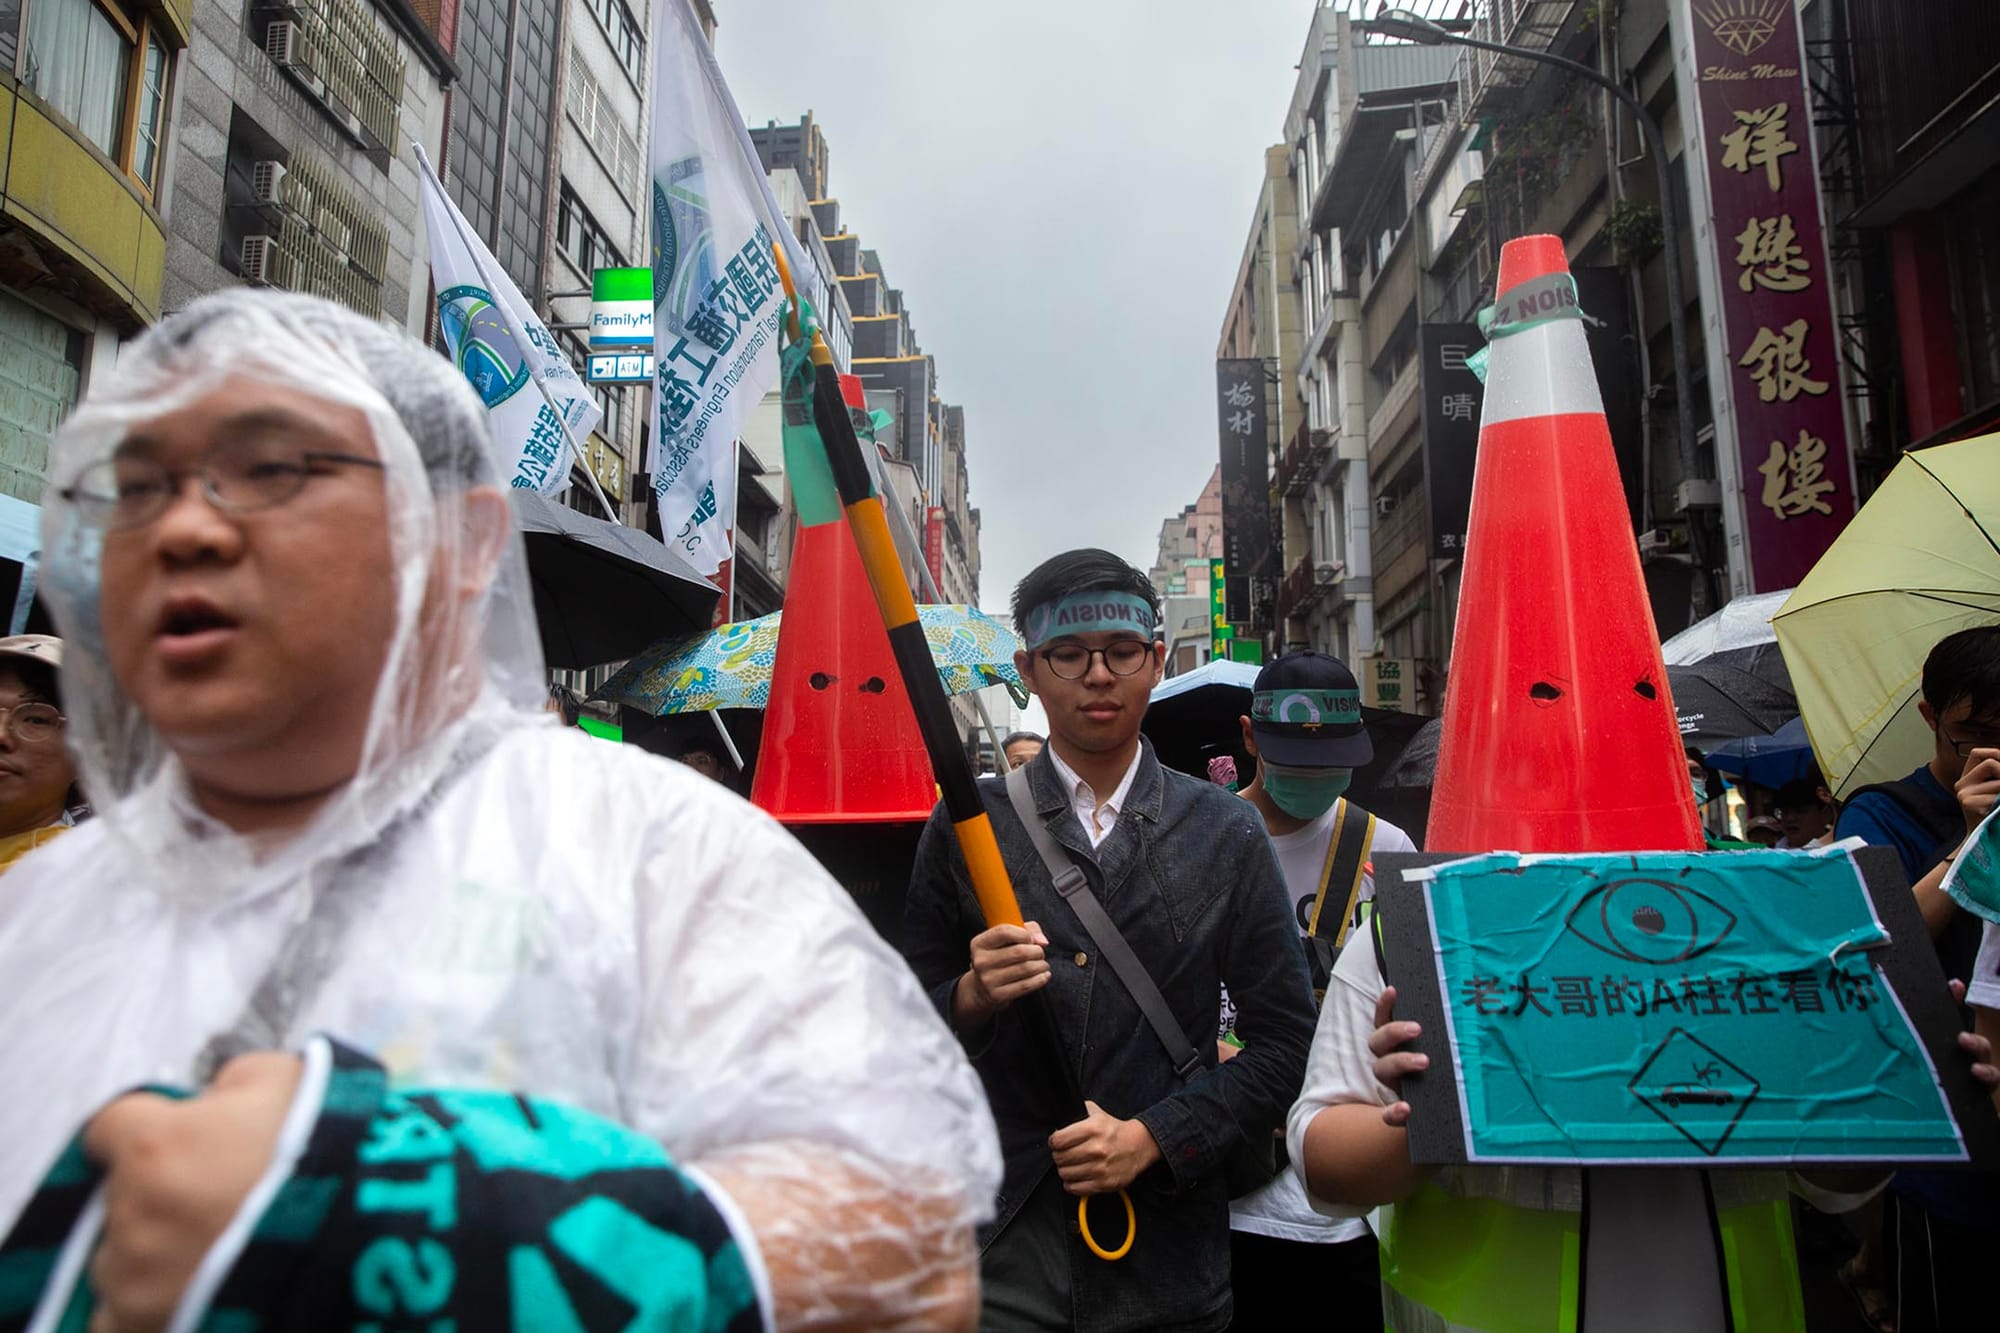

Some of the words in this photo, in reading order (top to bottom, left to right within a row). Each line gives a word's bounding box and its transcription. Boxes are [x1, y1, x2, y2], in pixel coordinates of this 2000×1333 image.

[1702, 66, 1748, 81] Shine
[1719, 102, 1838, 520] 祥懋銀樓
[620, 363, 639, 373] ATM
[1461, 968, 1880, 1018] 老大哥的A柱在看你
